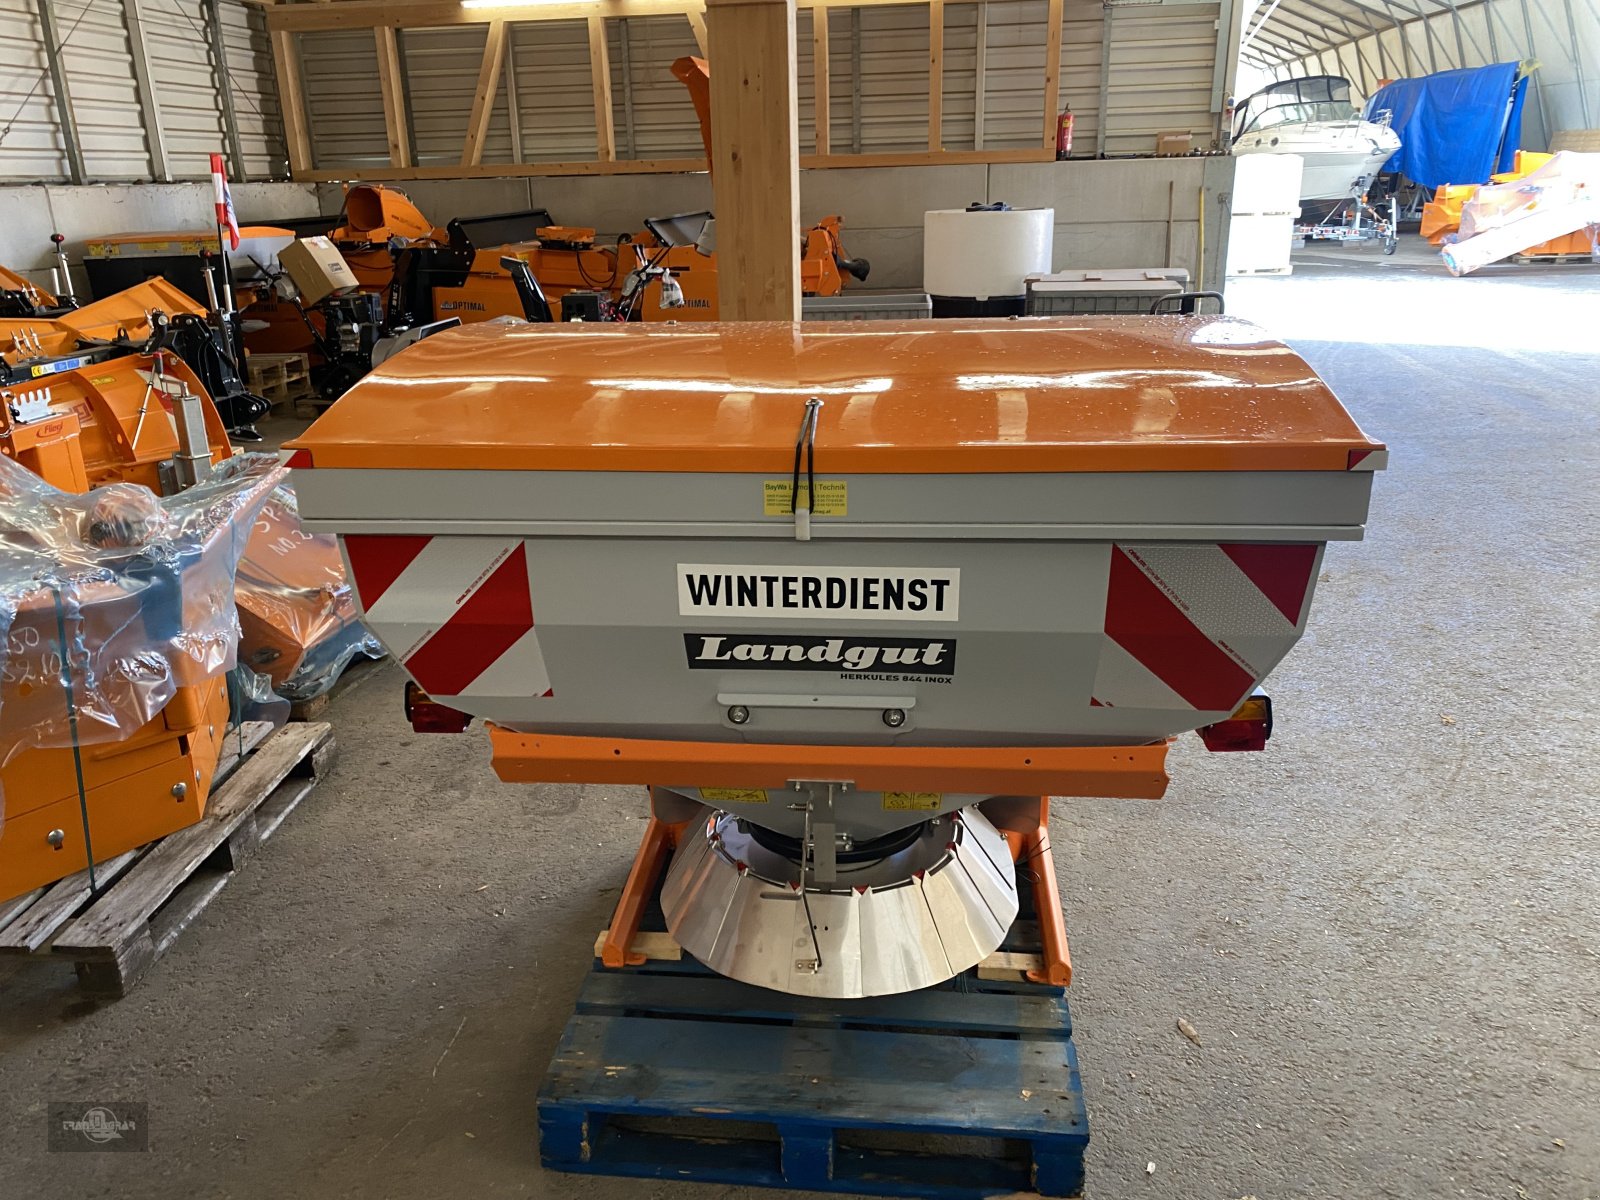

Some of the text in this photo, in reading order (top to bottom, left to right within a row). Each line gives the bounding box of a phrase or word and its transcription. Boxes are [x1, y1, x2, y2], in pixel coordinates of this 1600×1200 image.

[452, 301, 486, 312] OPTIMAL
[765, 483, 787, 492] BayWa
[819, 483, 846, 491] Technik
[685, 574, 950, 612] WINTERDIENST
[695, 636, 948, 670] Landgut
[840, 673, 952, 684] HERKULES 844 INOX
